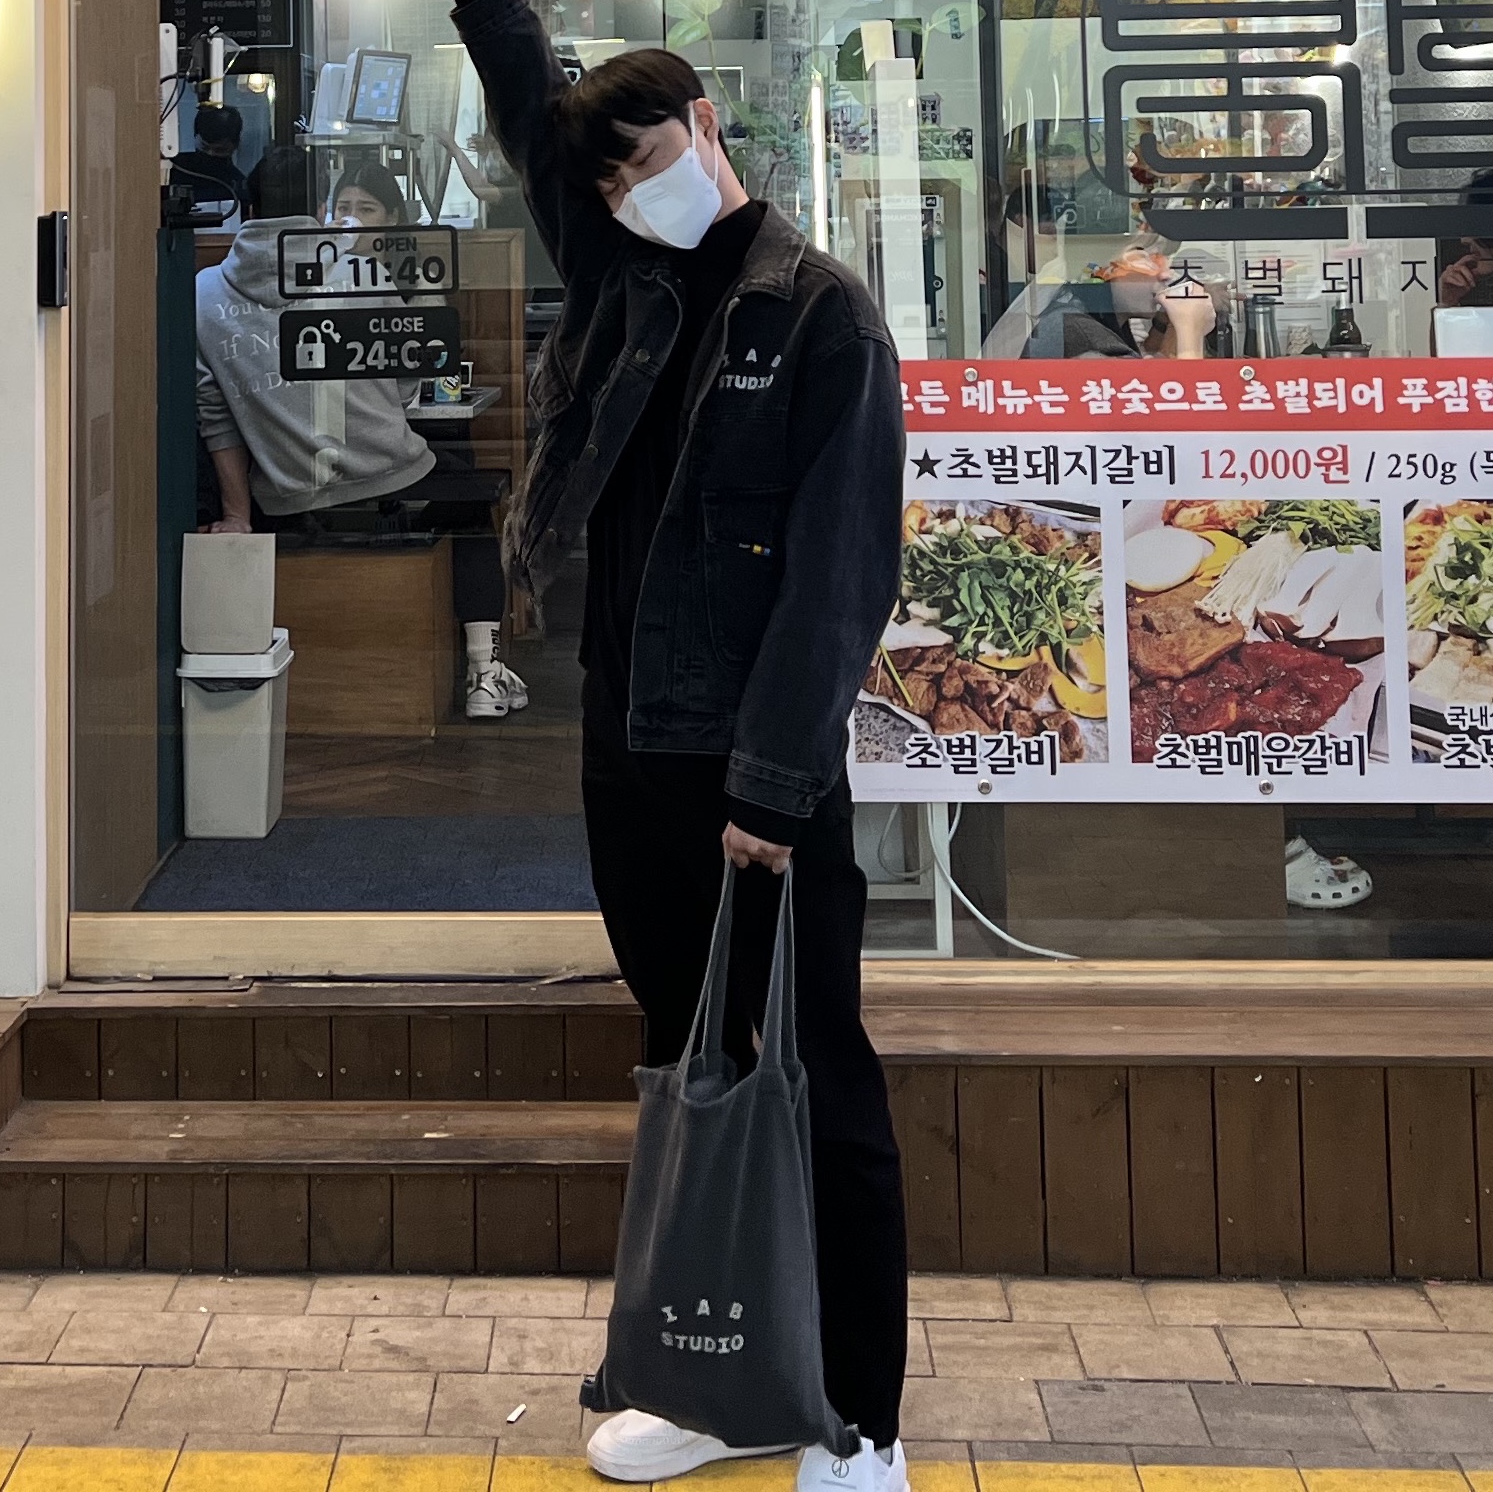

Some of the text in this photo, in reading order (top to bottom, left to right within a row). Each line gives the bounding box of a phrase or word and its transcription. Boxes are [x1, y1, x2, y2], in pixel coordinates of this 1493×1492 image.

[372, 237, 417, 253] OPEN
[347, 255, 446, 287] 11:40
[368, 316, 424, 333] CLOSE
[961, 379, 1070, 415] 메뉴는
[1080, 378, 1228, 415] 참숯으로
[1238, 377, 1385, 415] 초벌되어
[946, 444, 1176, 486] 초벌돼지갈비
[1200, 444, 1350, 485] 12,000원
[1387, 452, 1458, 485] 250g
[1448, 705, 1493, 729] 국내
[906, 734, 1058, 776] 초벌갈비
[1156, 734, 1368, 777] 초벌매운갈비
[661, 1331, 744, 1354] STUDIO
